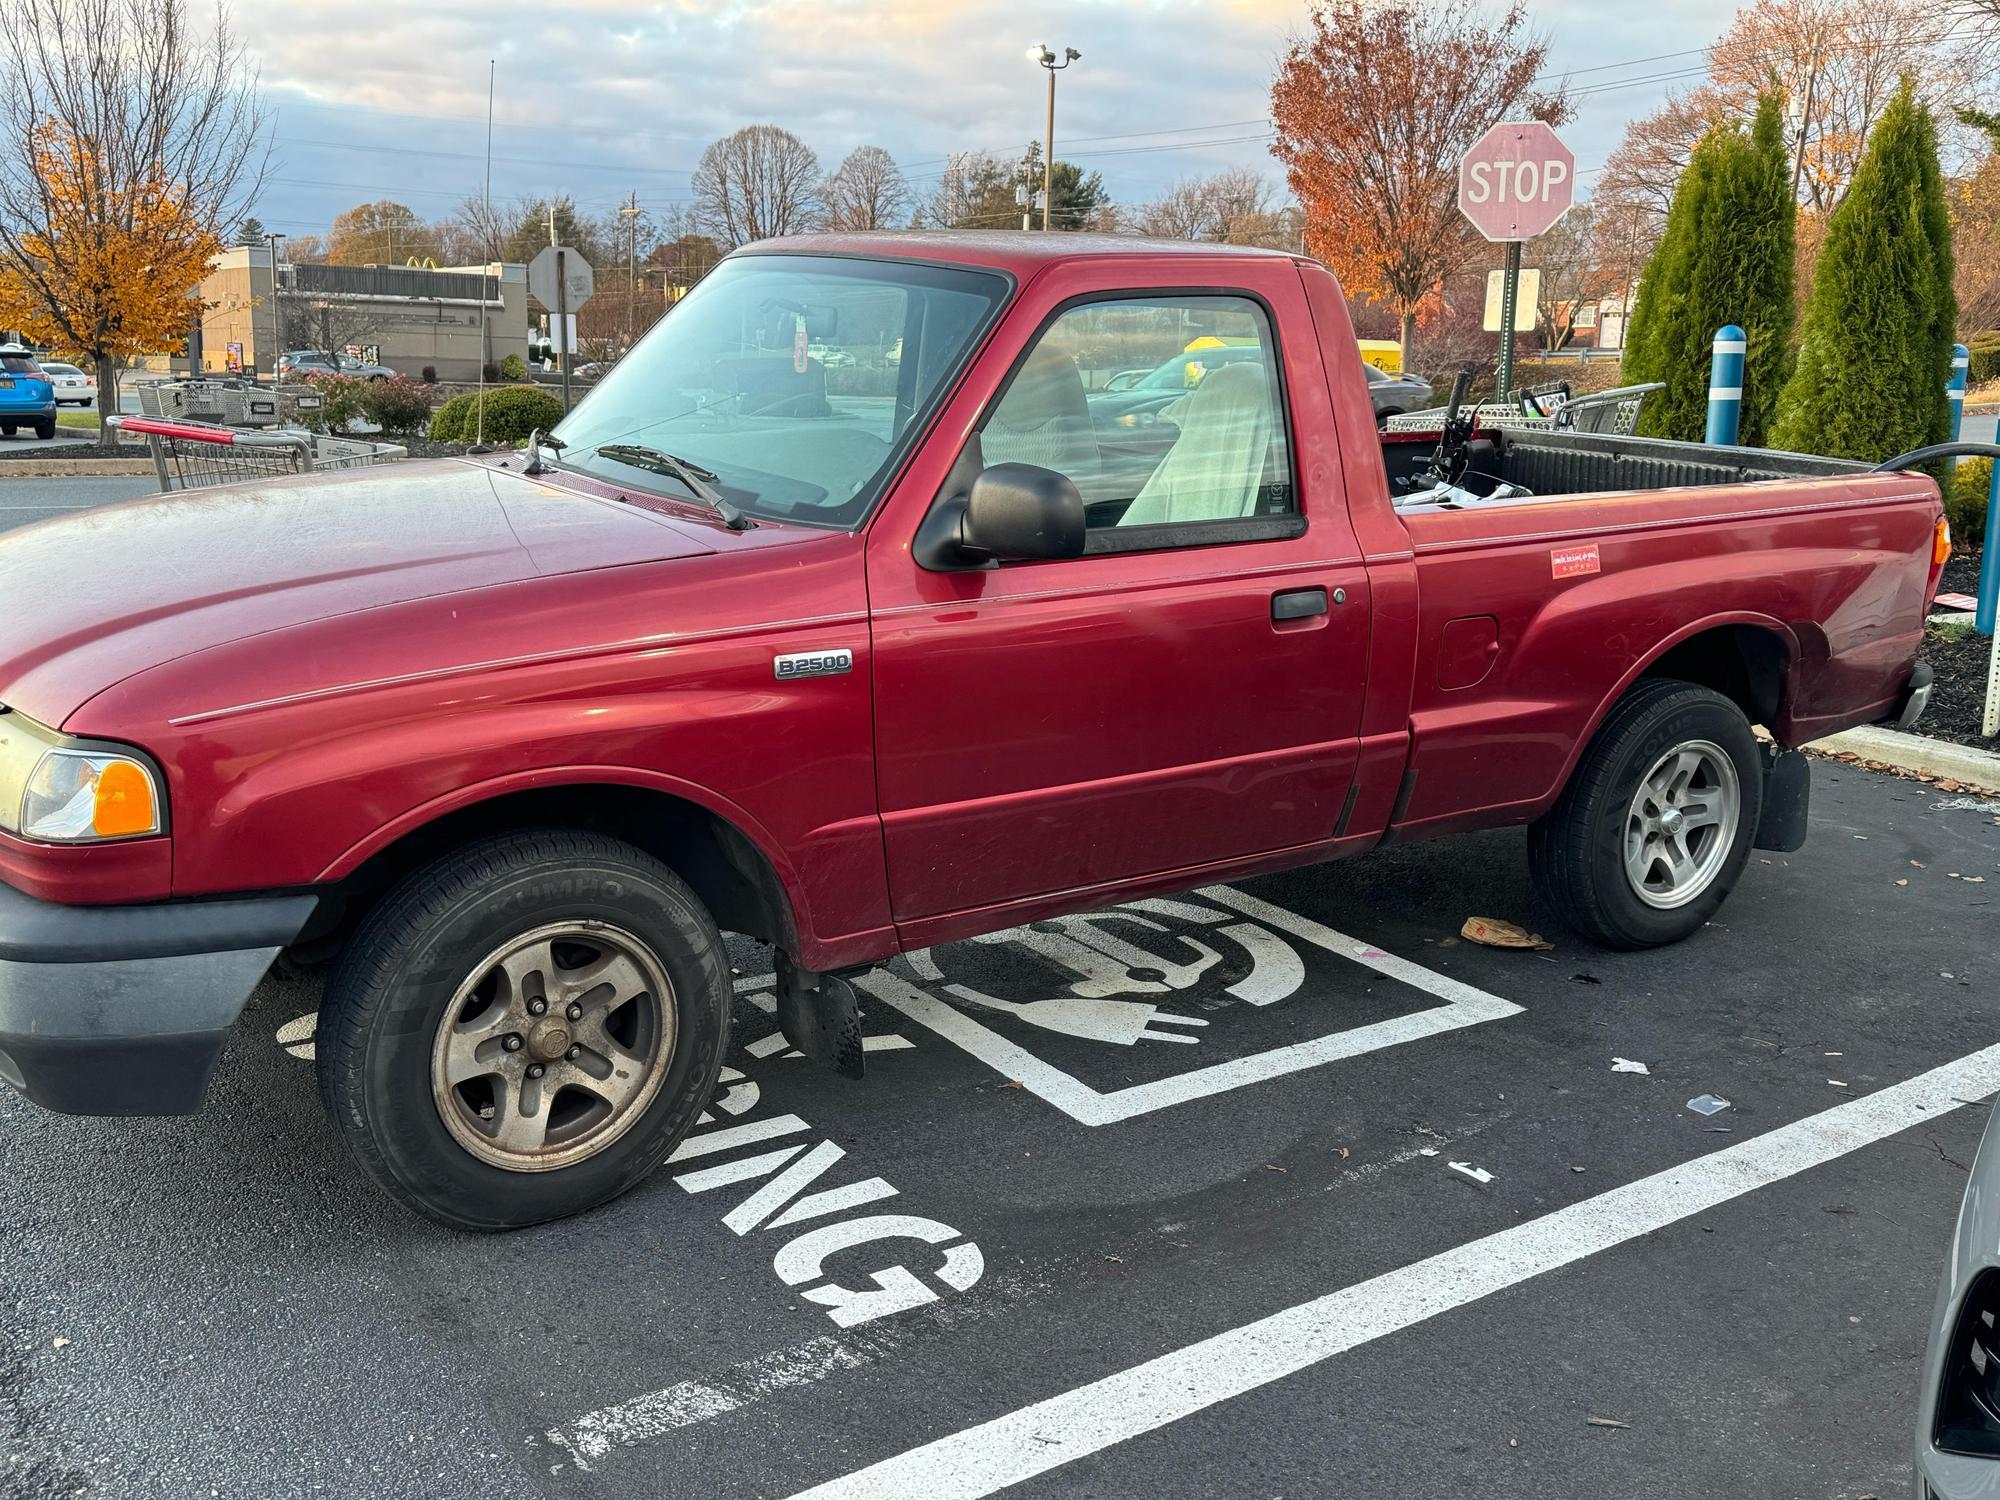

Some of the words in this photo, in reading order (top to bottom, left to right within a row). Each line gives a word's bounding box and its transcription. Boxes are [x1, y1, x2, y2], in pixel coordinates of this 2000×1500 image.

[1467, 160, 1567, 204] STOP
[779, 655, 849, 674] B2500
[1633, 713, 1694, 771] SOLUS
[489, 879, 625, 914] KUMHO
[643, 1038, 713, 1158] SOLUS
